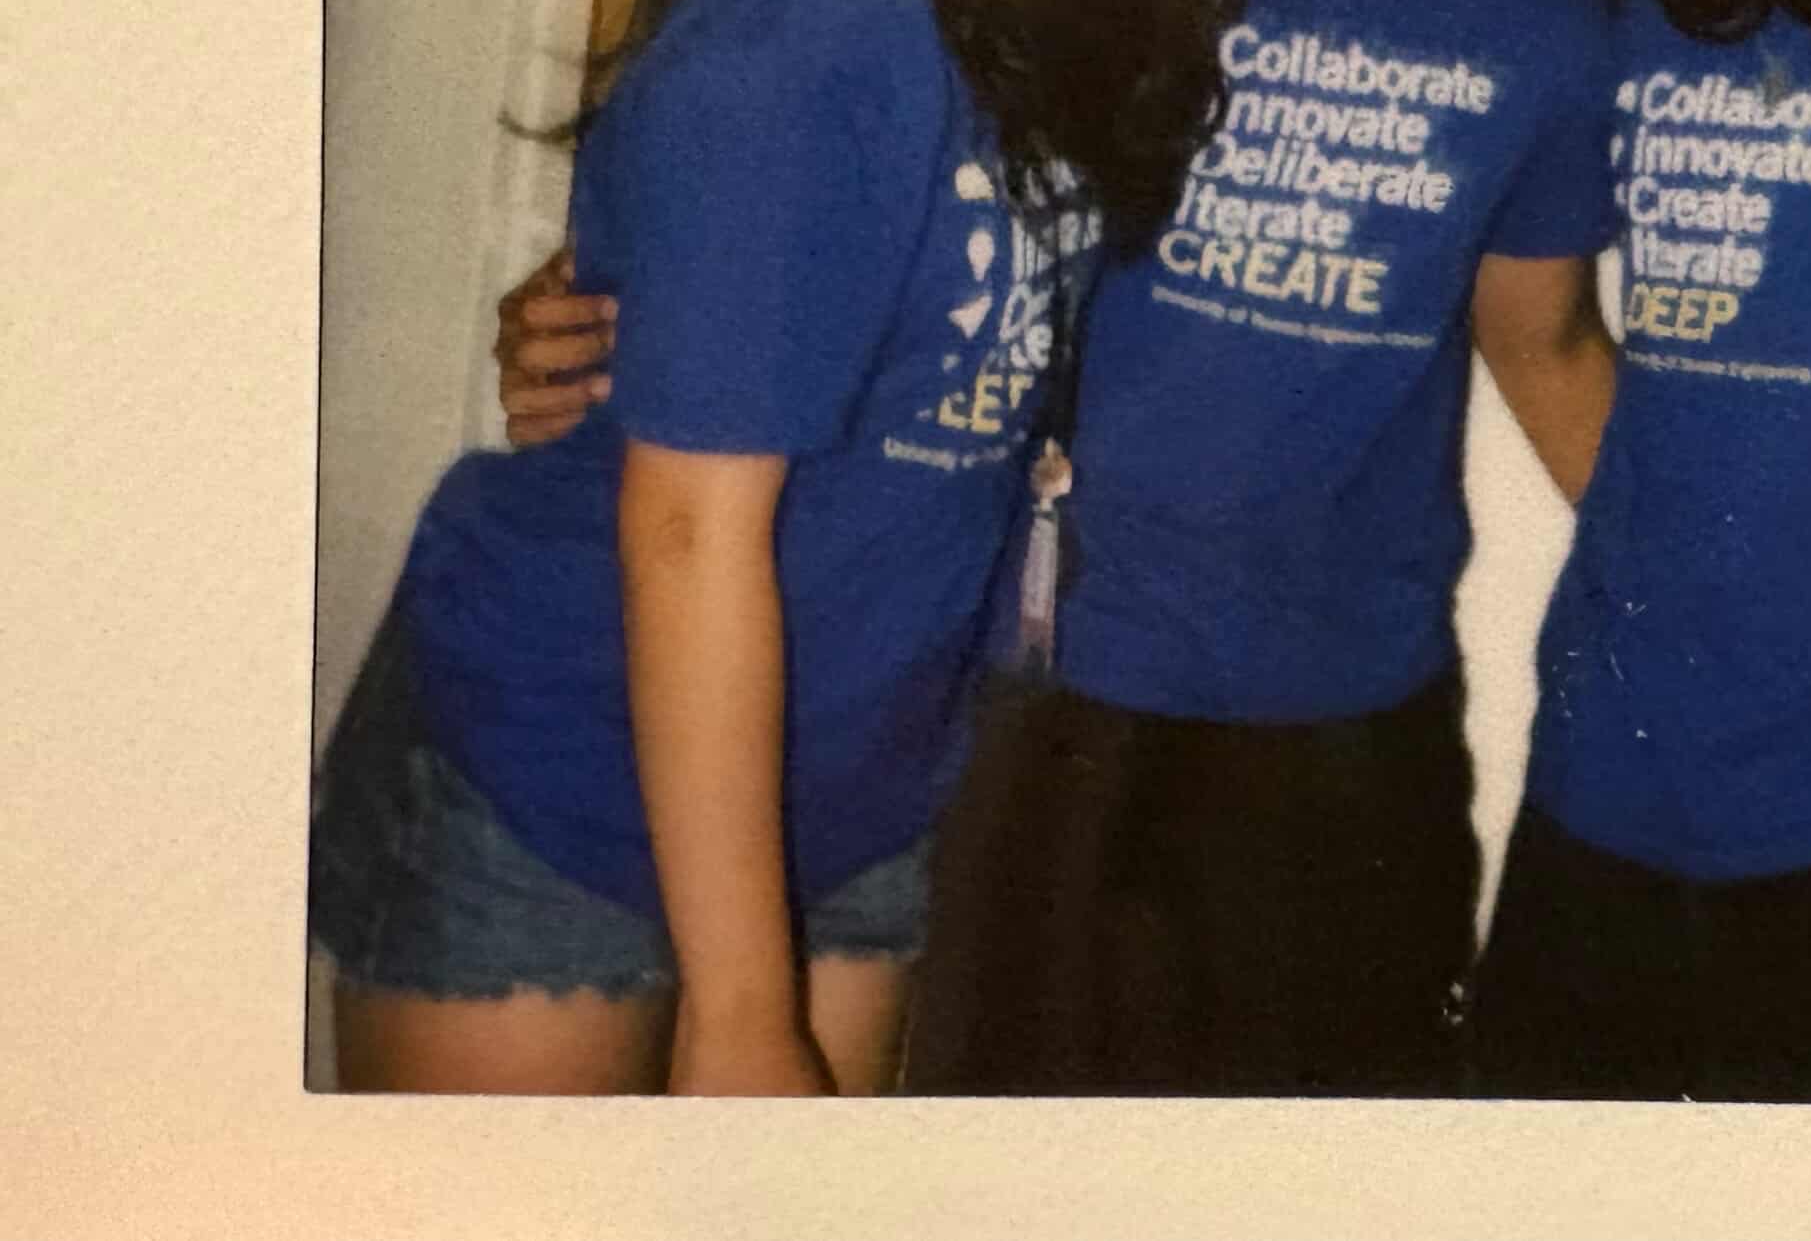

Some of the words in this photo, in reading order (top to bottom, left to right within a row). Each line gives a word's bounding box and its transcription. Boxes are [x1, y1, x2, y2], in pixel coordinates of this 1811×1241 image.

[1218, 22, 1495, 115] Collaborate
[1189, 130, 1455, 214] Deliberate
[1628, 175, 1773, 234] Create
[1175, 175, 1352, 249] Iterate
[1157, 229, 1390, 315] CREATE
[1630, 226, 1764, 289] Iterate
[1624, 281, 1741, 344] DEEP
